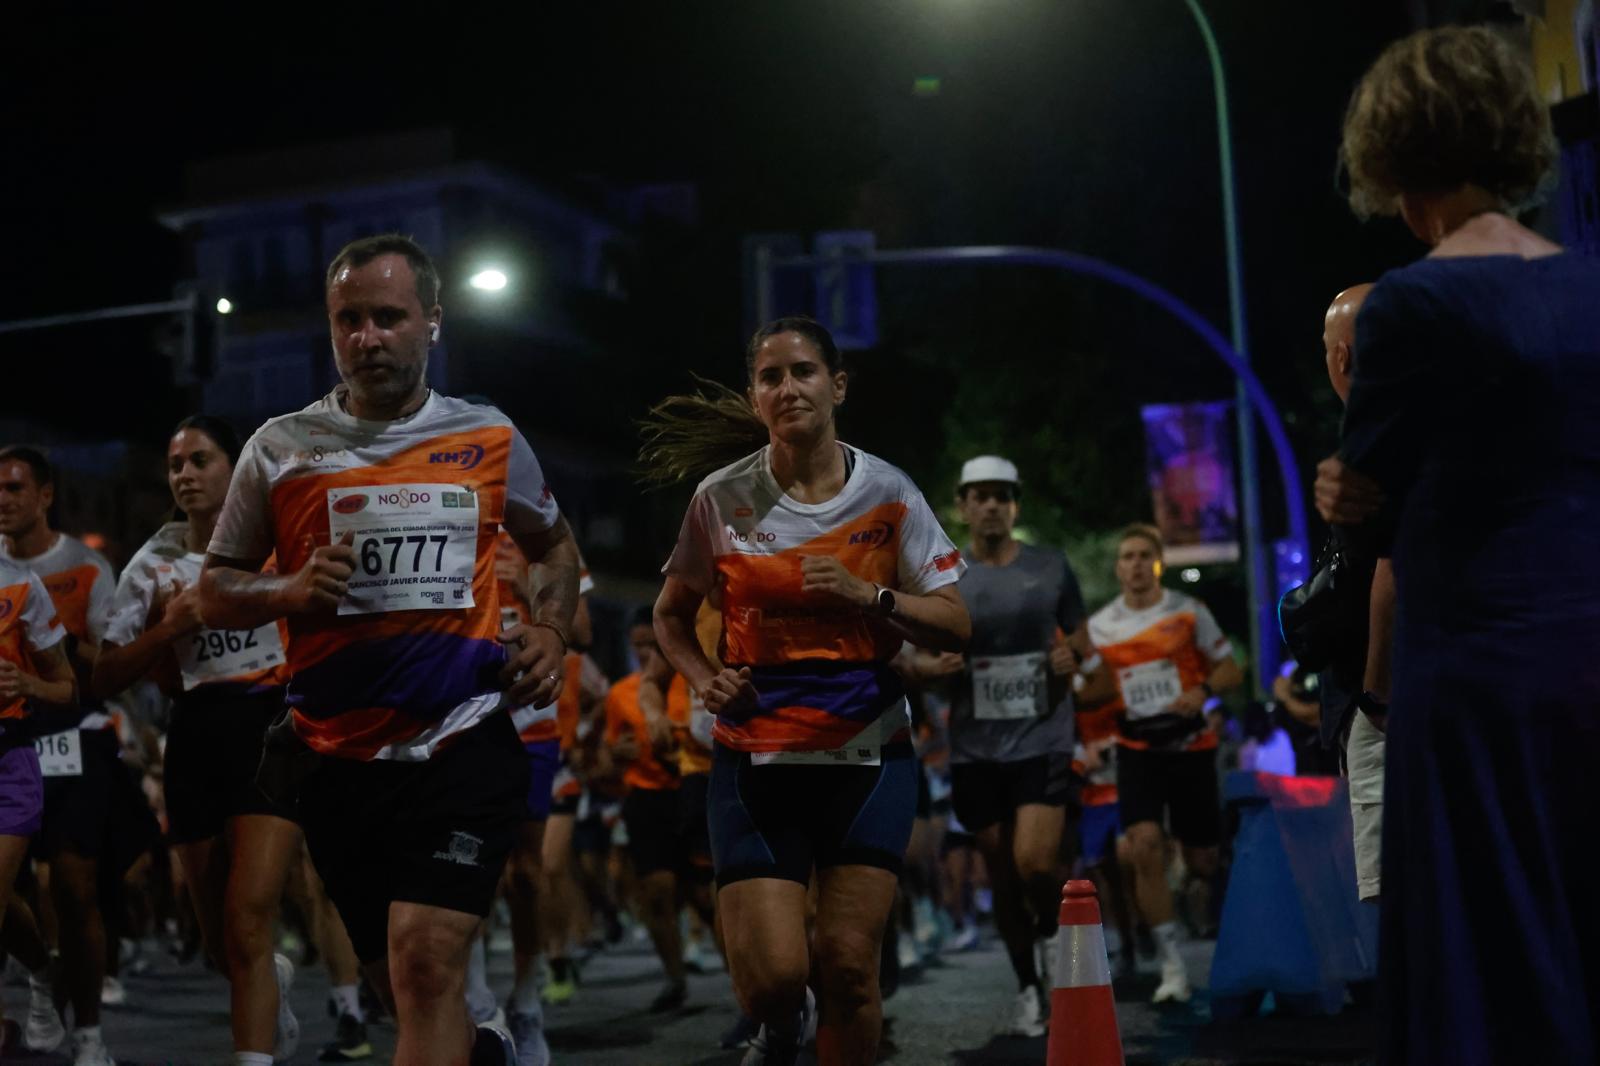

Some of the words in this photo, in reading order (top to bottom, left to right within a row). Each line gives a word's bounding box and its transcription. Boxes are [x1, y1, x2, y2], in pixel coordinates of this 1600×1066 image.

[361, 535, 448, 576] 6777
[390, 576, 419, 585] JAVIER
[192, 629, 258, 661] 2962
